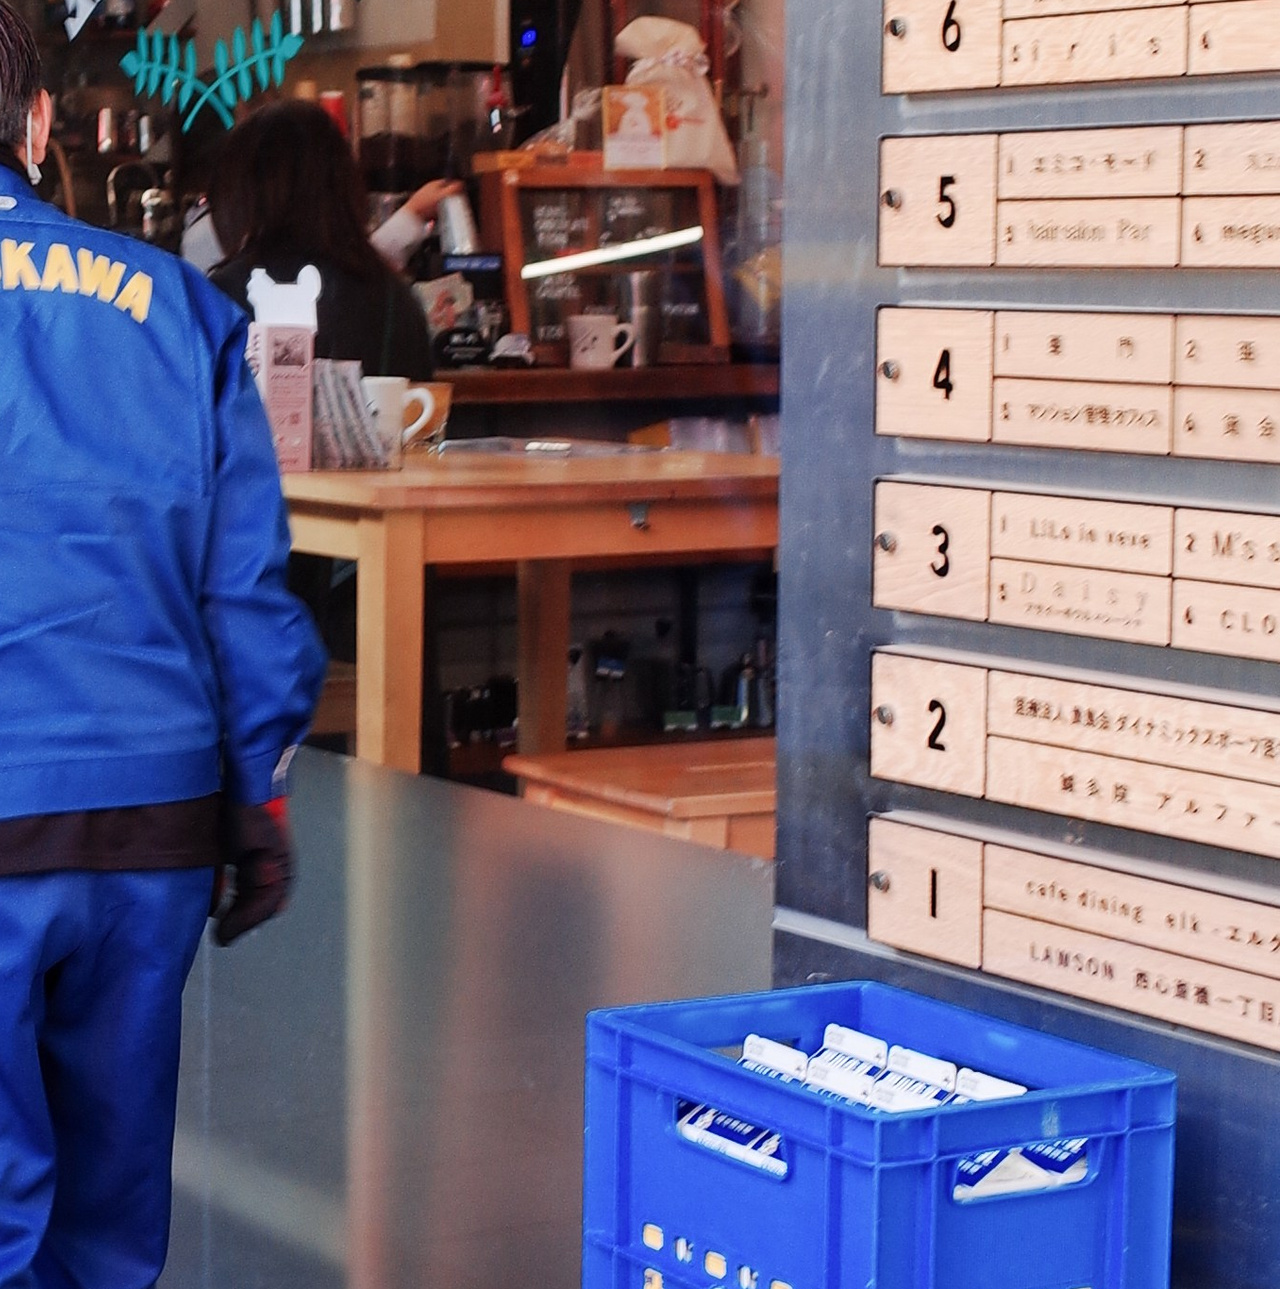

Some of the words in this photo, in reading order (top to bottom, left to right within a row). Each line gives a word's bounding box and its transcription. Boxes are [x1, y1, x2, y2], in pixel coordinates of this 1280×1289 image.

[1193, 148, 1206, 169] 2
[936, 174, 957, 229] 5
[1184, 339, 1197, 359] 2
[932, 348, 953, 400] 4
[1183, 412, 1195, 434] 6
[931, 524, 949, 578] 3
[1185, 532, 1196, 552] 2
[927, 697, 947, 752] 2
[930, 867, 938, 920] 1
[1077, 888, 1144, 925] dining
[1028, 939, 1116, 981] LAWSON
